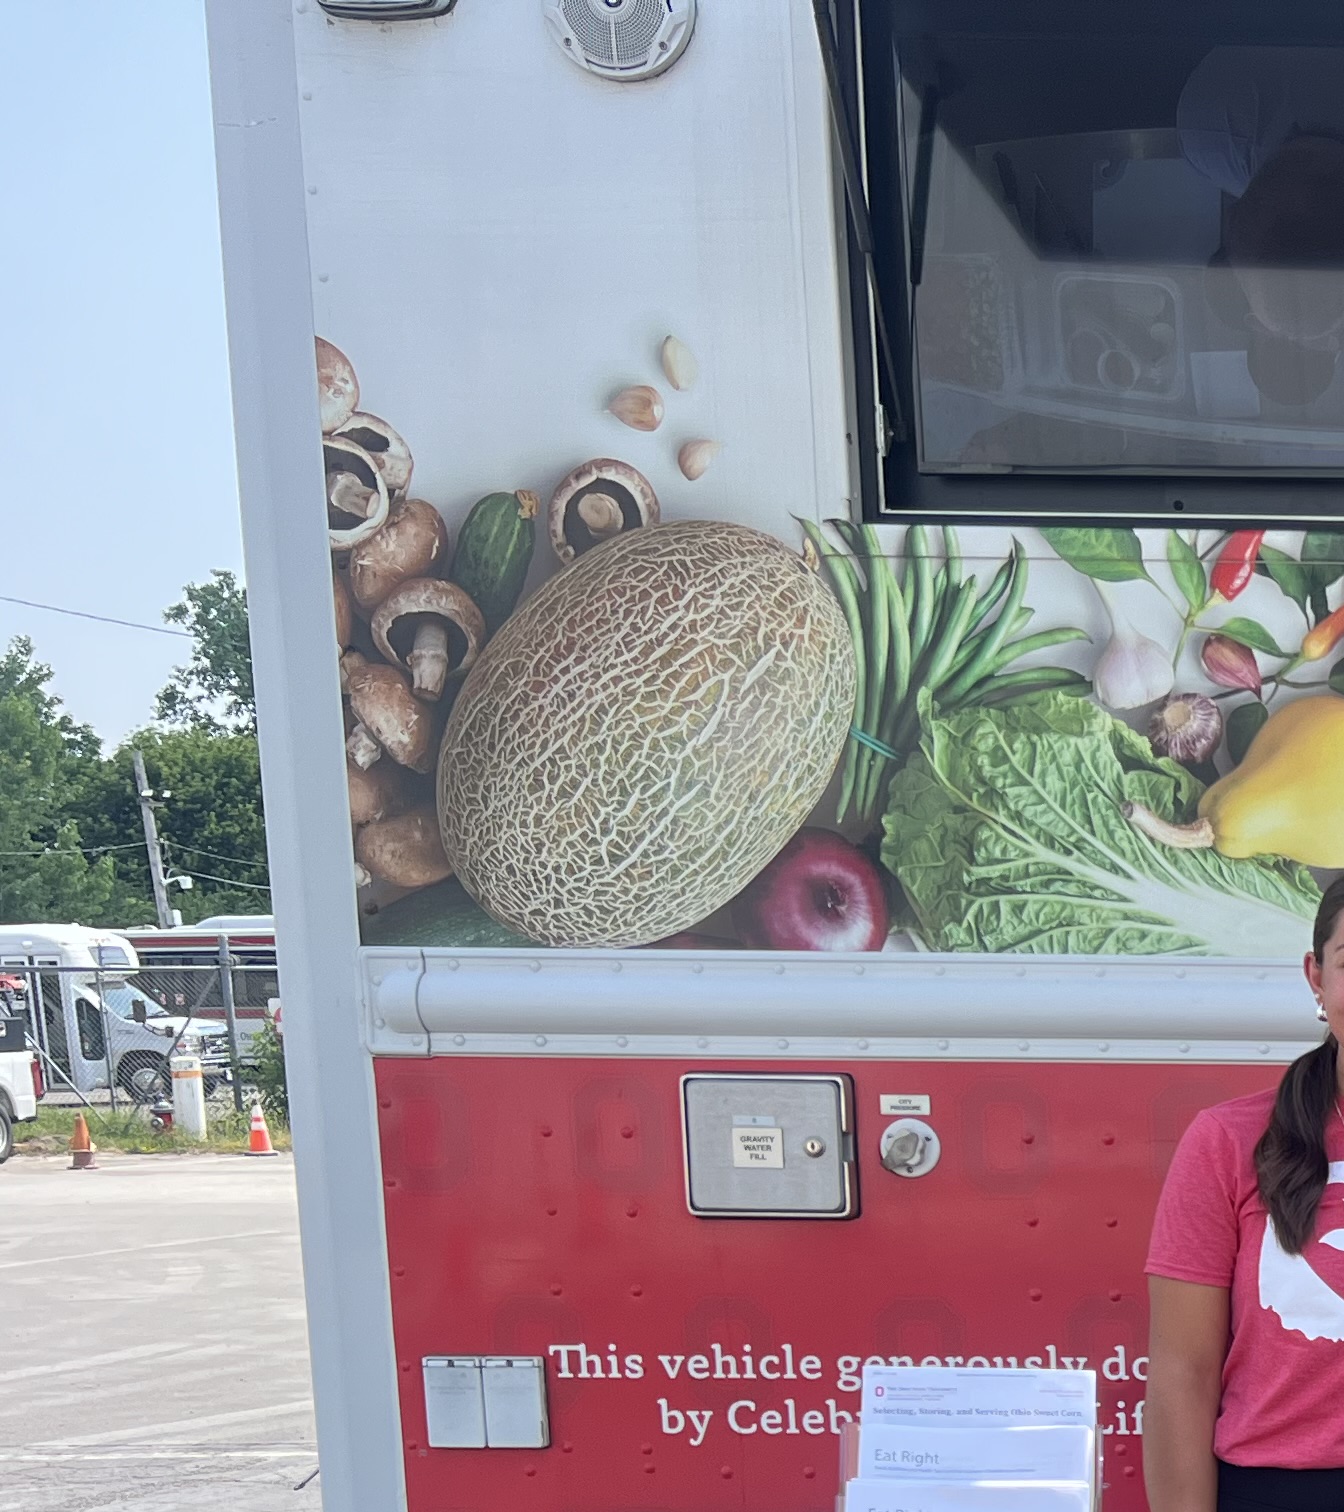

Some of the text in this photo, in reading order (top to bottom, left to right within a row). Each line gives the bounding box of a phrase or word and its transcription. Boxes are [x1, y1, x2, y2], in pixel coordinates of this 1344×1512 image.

[548, 1343, 645, 1379] This
[657, 1343, 822, 1380] vehicle
[657, 1398, 714, 1446] by
[727, 1398, 863, 1435] Celeb
[874, 1449, 940, 1468] Eat Right
